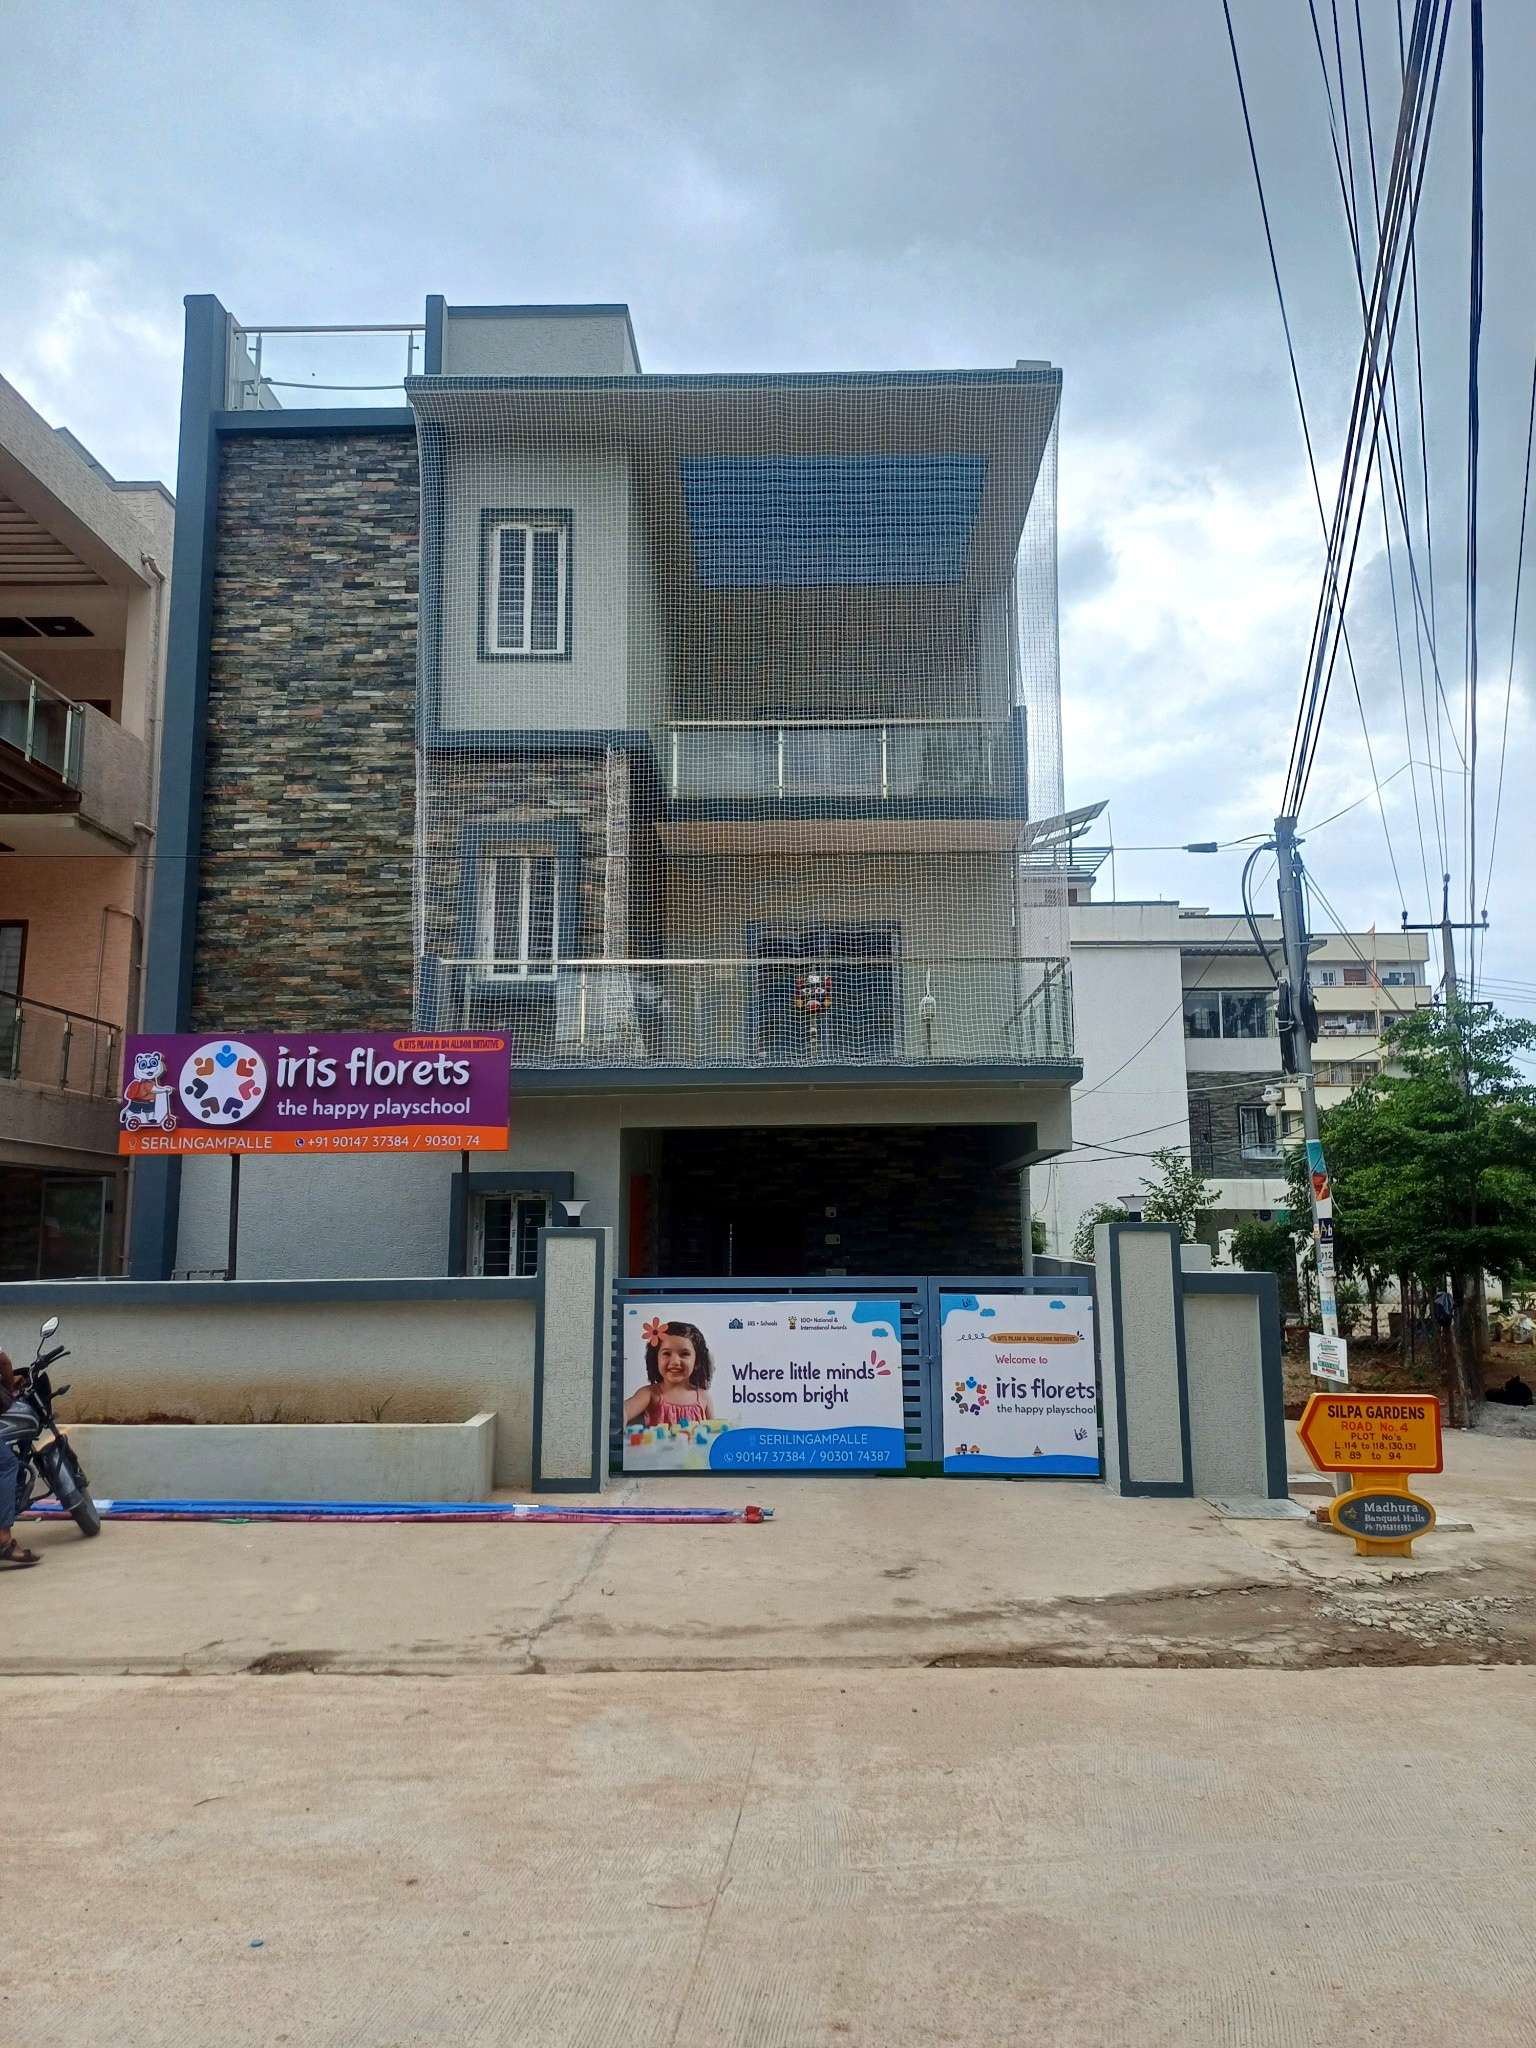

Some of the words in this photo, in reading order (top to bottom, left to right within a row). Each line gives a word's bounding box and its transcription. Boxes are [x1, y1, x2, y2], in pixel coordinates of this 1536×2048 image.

[276, 1046, 308, 1087] iris
[345, 1047, 470, 1087] florets
[277, 1099, 307, 1116] the
[312, 1098, 369, 1119] happy
[373, 1097, 470, 1119] playschool
[141, 1136, 272, 1150] SERLINGAMPALLE
[308, 1136, 328, 1148] +91
[332, 1136, 368, 1148] 90147
[372, 1136, 408, 1147] 37384
[413, 1134, 421, 1148] /
[425, 1135, 460, 1146] 90301
[466, 1135, 480, 1146] 74
[995, 1354, 1036, 1364] Welcome
[1039, 1356, 1048, 1364] to
[732, 1362, 784, 1380] Where
[790, 1361, 820, 1380] little
[826, 1361, 875, 1380] minds
[996, 1376, 1027, 1398] iris
[1030, 1378, 1095, 1398] florets
[732, 1385, 798, 1403] blossom
[804, 1384, 848, 1410] bright
[996, 1404, 1012, 1413] the
[1015, 1404, 1044, 1416] happy
[1046, 1404, 1096, 1416] playschool
[1328, 1404, 1362, 1418] SILPA
[1366, 1406, 1424, 1420] GARDENS
[1342, 1422, 1372, 1431] ROAD
[760, 1434, 868, 1446] SERILINGAMPALLE
[736, 1452, 768, 1462] 90147
[773, 1451, 806, 1462] 37384
[809, 1450, 816, 1464] /
[820, 1450, 853, 1462] 90301
[858, 1450, 890, 1462] 74387
[1335, 1451, 1342, 1459] R
[1372, 1452, 1381, 1460] to
[1388, 1452, 1401, 1460] 94
[1364, 1502, 1418, 1512] Madhura
